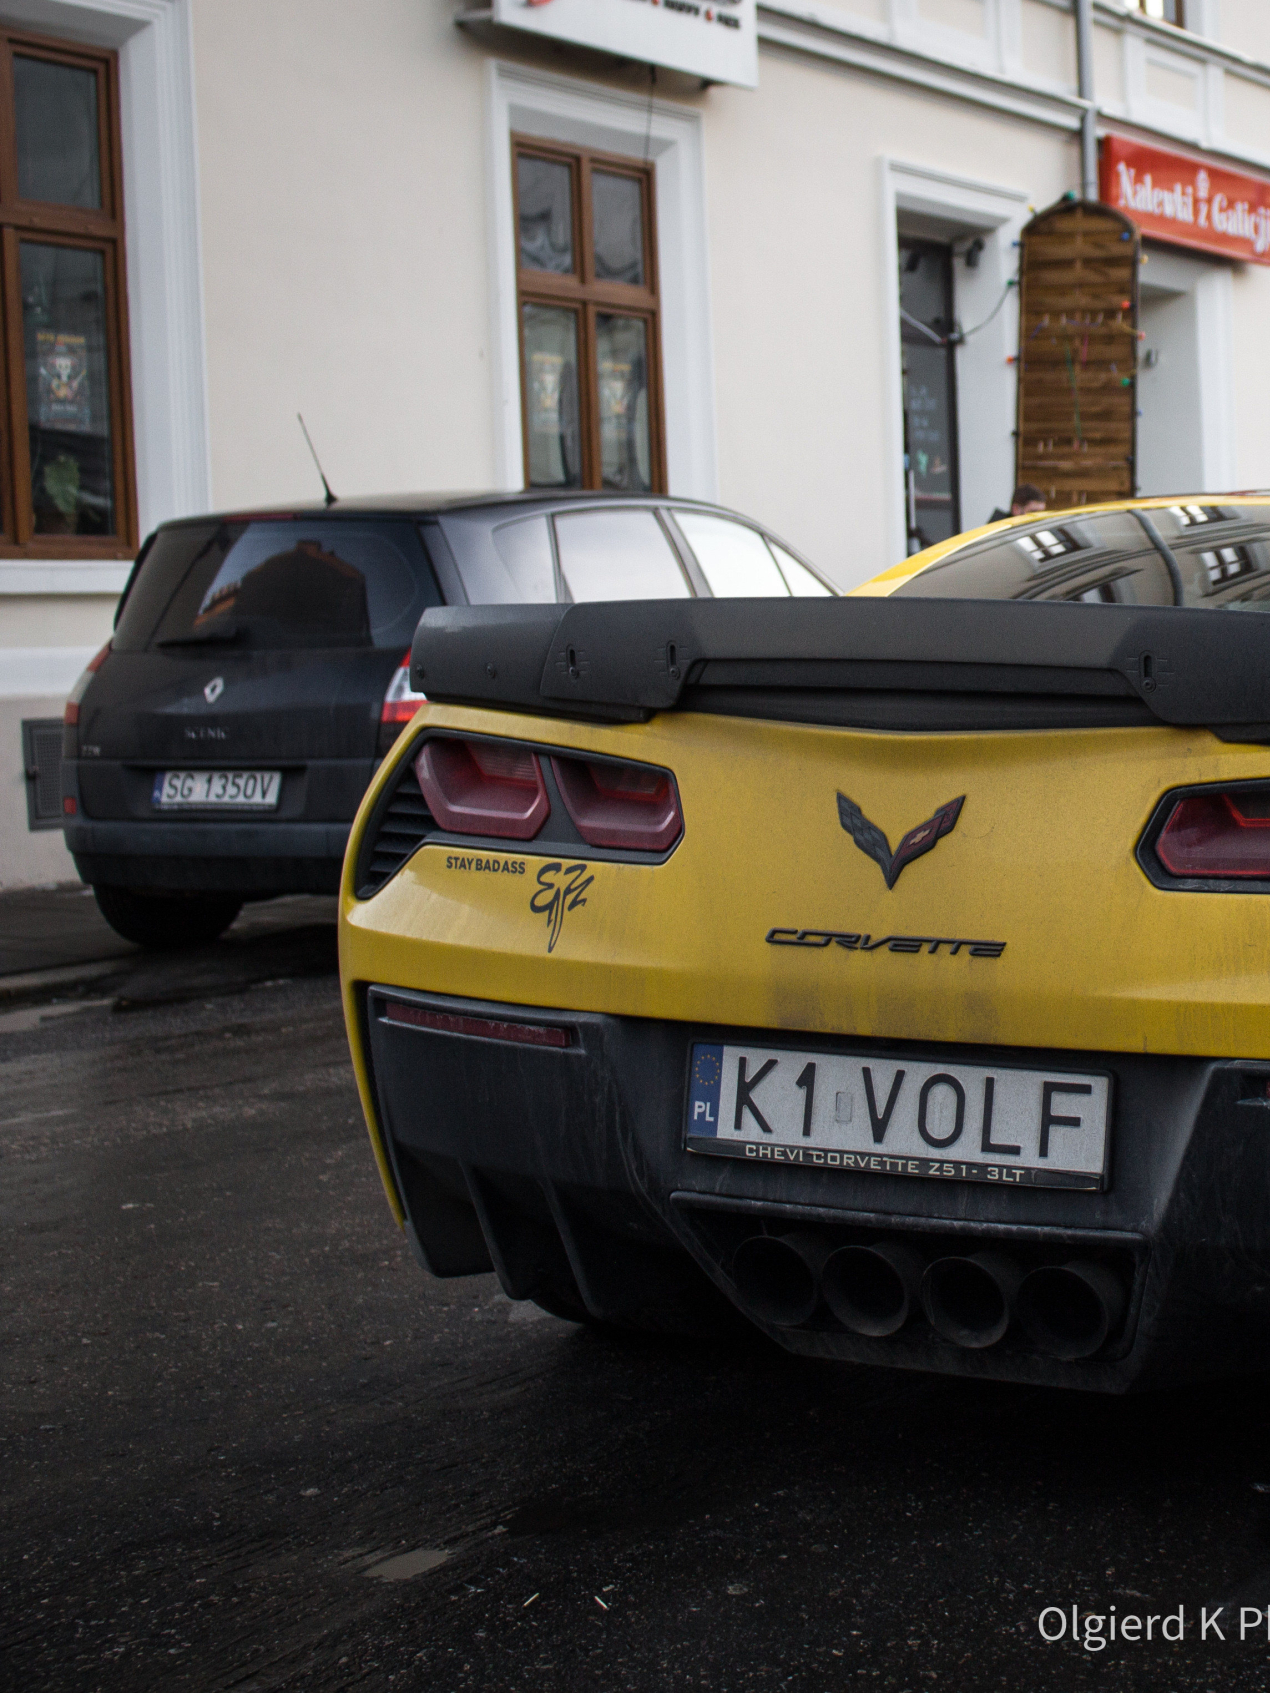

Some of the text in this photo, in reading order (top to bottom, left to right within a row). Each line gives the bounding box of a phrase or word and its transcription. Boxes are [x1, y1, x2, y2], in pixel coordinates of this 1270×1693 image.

[1117, 160, 1194, 224] Nalewki
[166, 773, 276, 800] SG 1350V
[446, 855, 474, 871] STAY
[765, 927, 1007, 957] CORVETTE
[693, 1100, 715, 1123] PL
[732, 1055, 1093, 1159] K1 VOLF
[745, 1144, 804, 1163] CHEVI
[813, 1151, 920, 1175] CORVETTE
